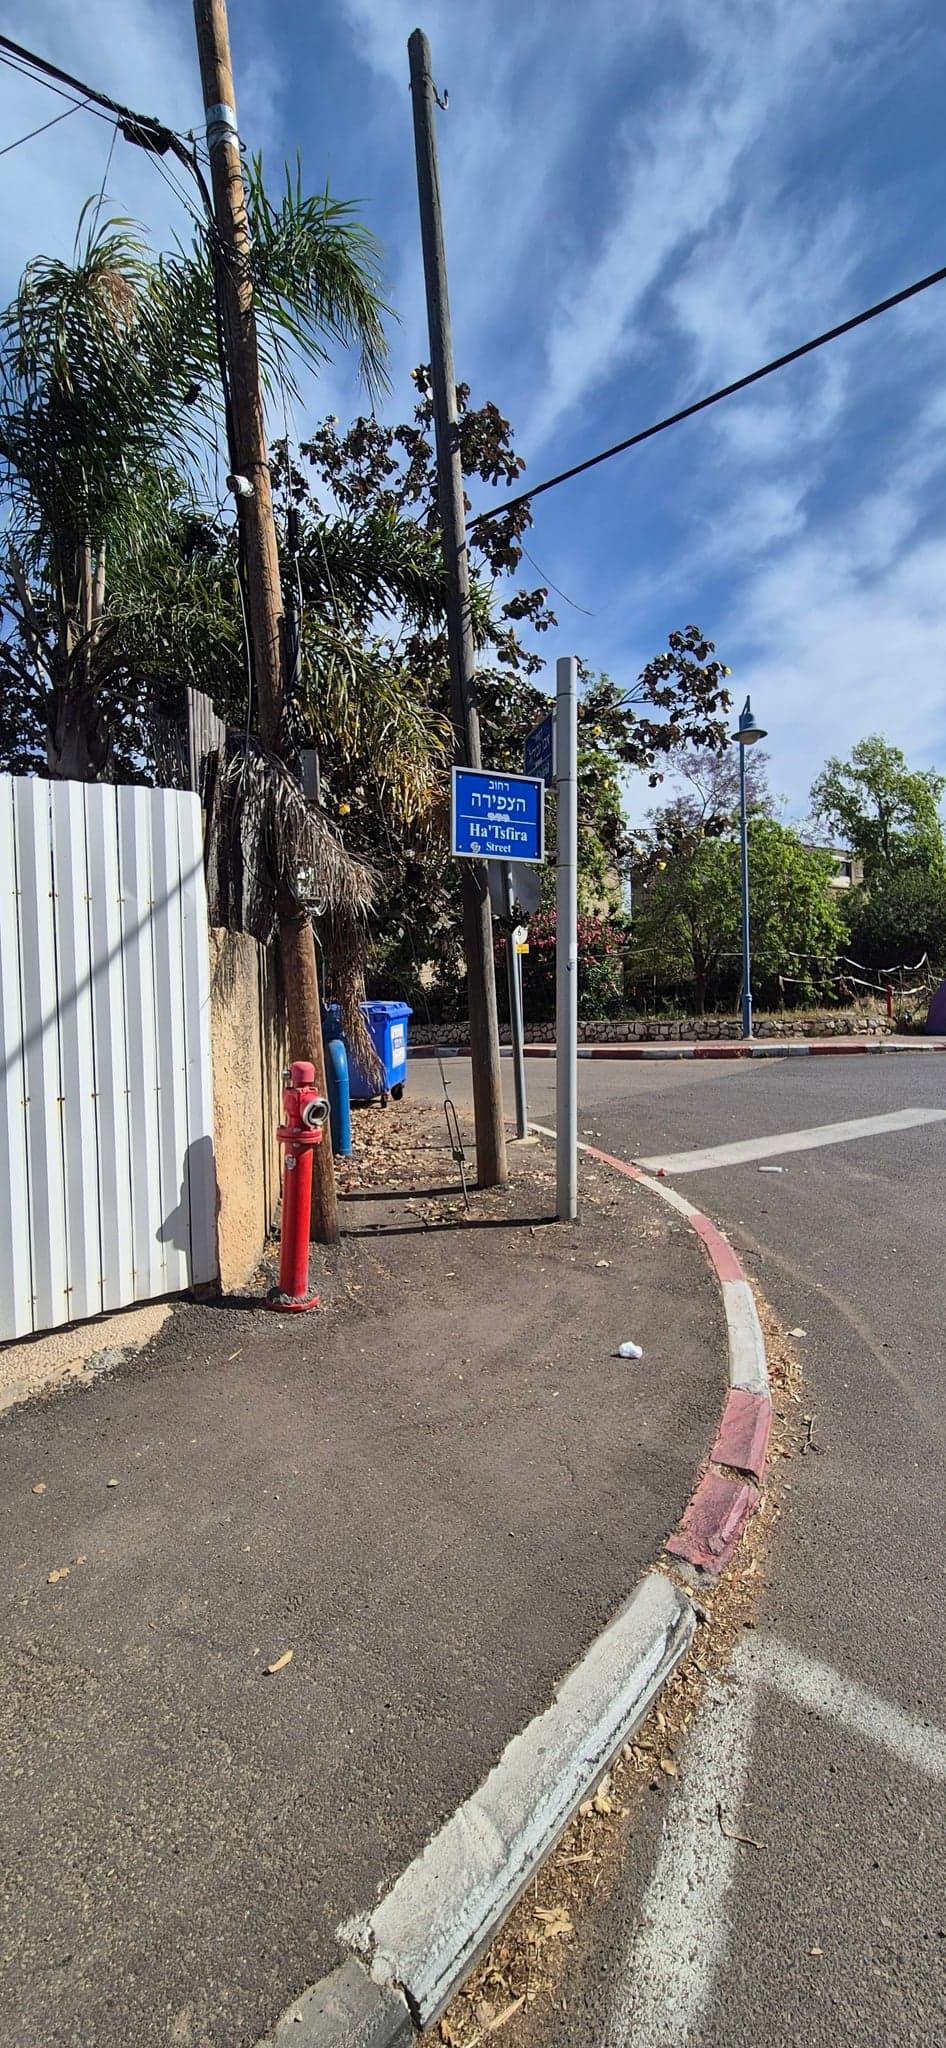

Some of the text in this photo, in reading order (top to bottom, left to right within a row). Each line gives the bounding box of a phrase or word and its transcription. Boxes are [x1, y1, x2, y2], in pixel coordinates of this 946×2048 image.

[488, 780, 510, 792] רחוב
[471, 792, 526, 812] הצפירה
[469, 823, 528, 842] Ha'Tsfira
[486, 841, 512, 853] Street
